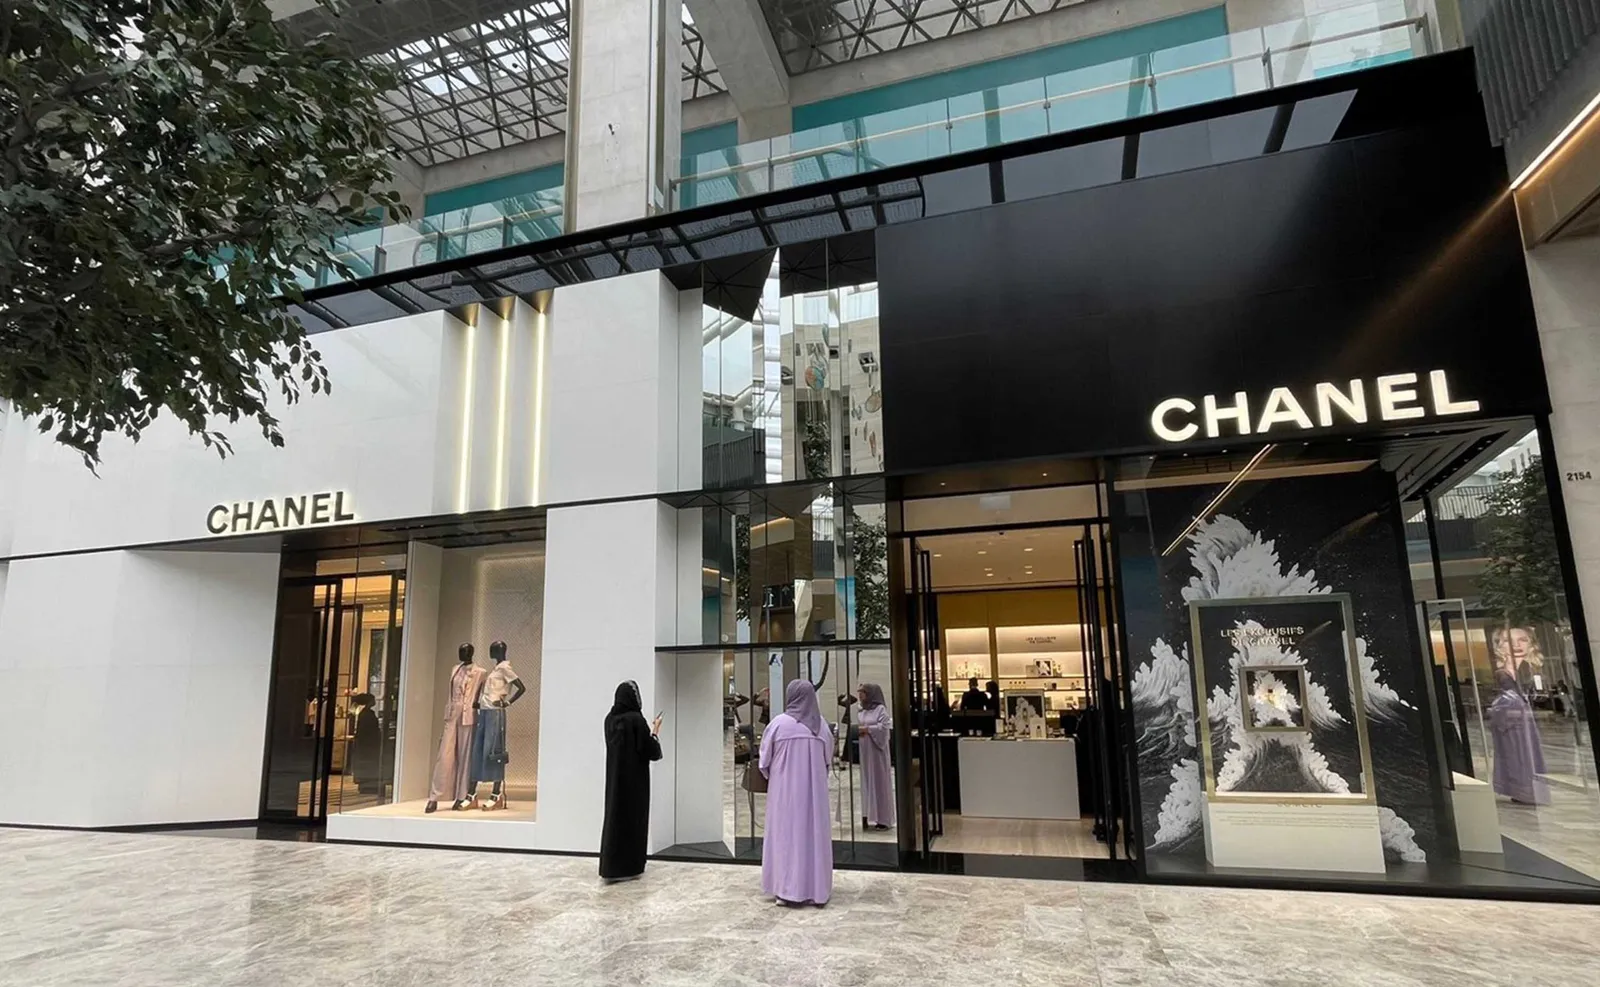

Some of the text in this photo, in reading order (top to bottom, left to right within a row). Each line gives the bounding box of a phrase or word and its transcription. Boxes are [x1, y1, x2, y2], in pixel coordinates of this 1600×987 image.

[1151, 370, 1480, 442] CHANEL
[1566, 471, 1592, 481] 2154
[207, 491, 355, 534] CHANEL
[1221, 629, 1242, 637] LES
